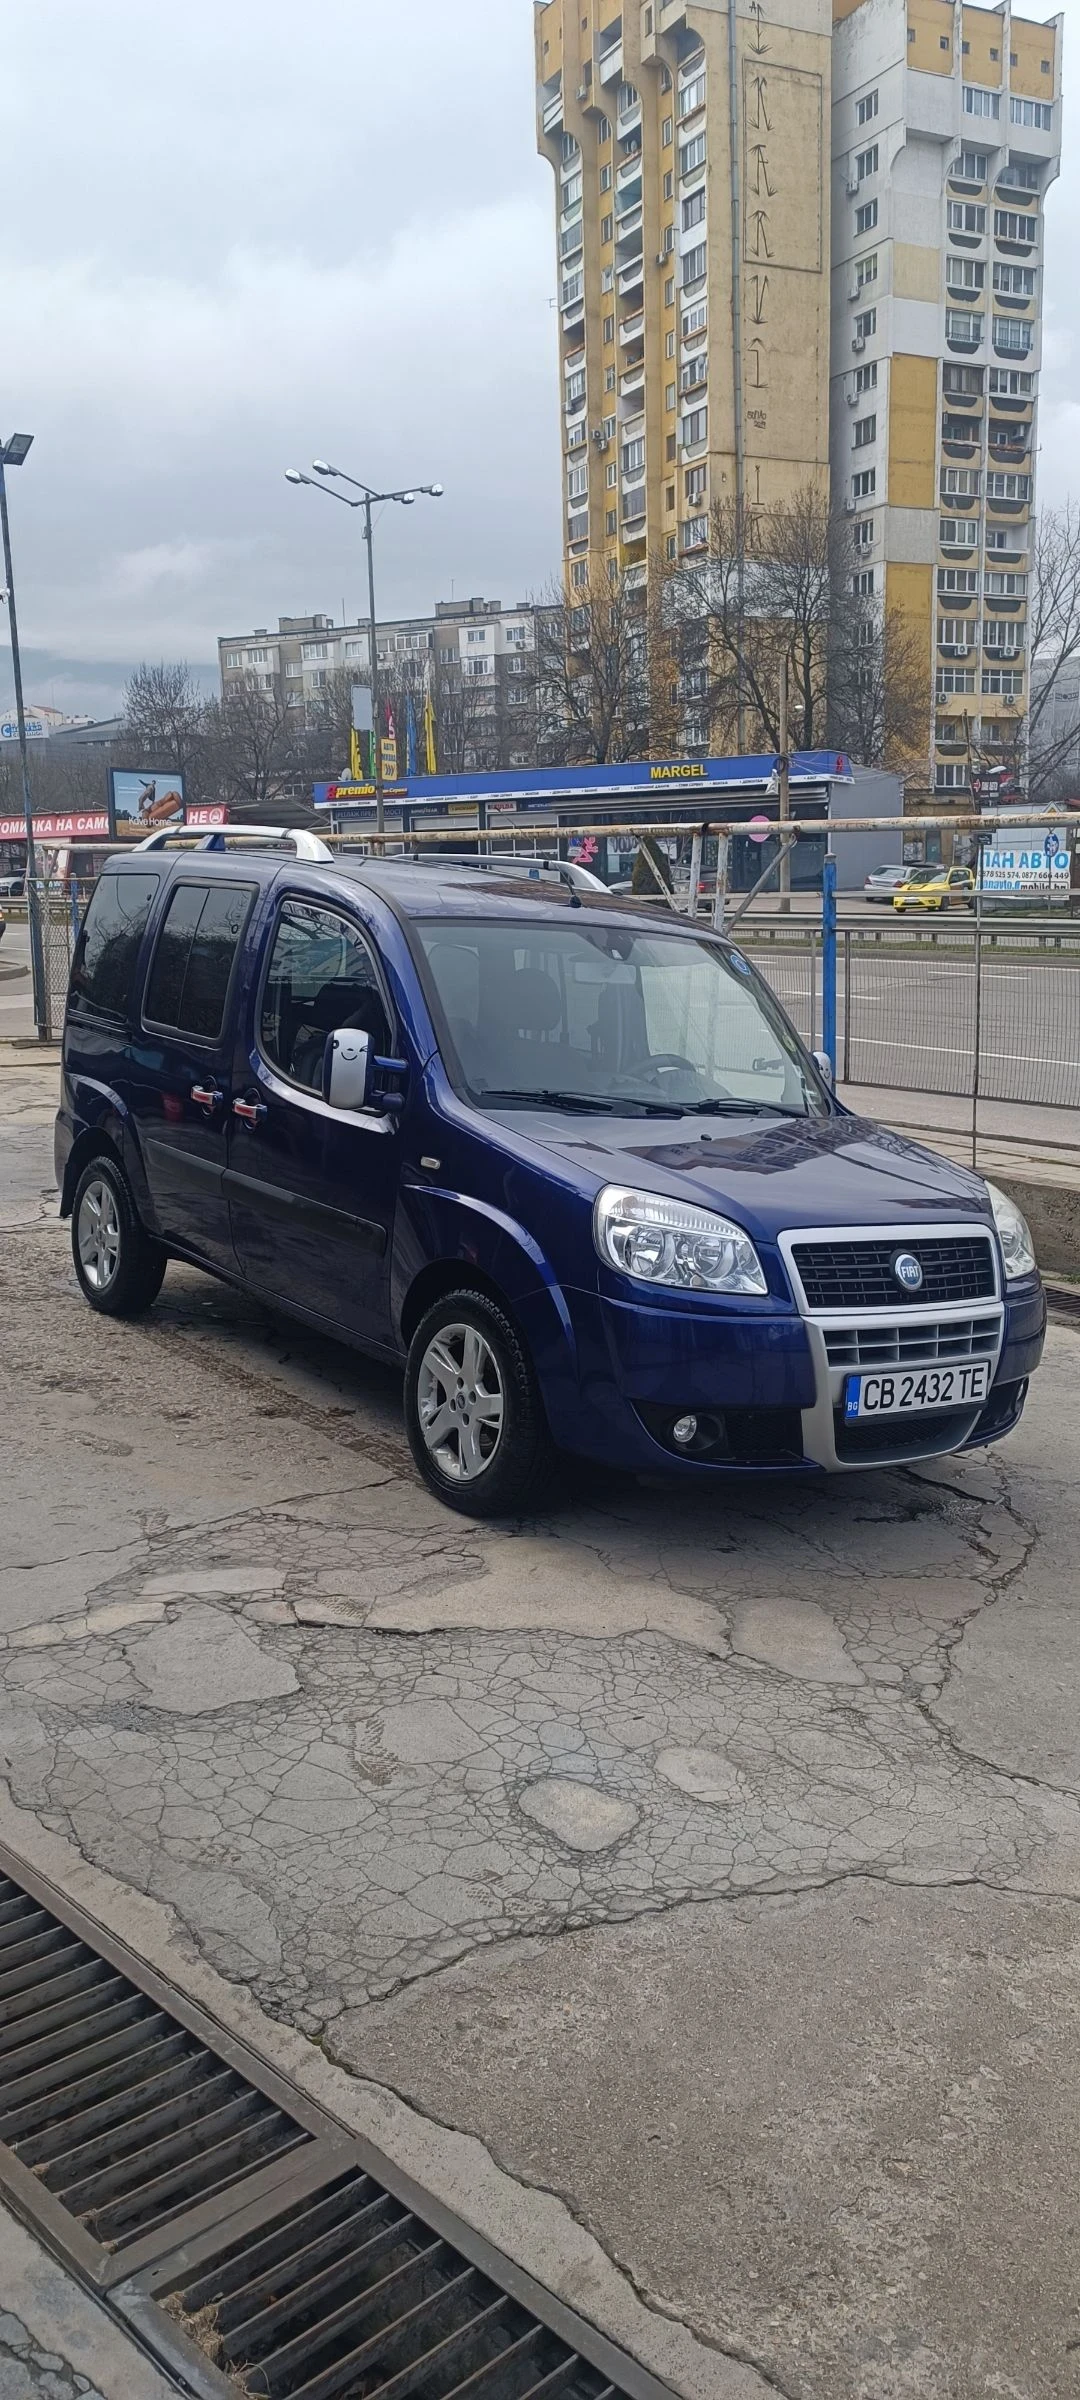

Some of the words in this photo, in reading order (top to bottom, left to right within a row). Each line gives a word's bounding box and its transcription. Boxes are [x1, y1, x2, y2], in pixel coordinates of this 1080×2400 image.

[650, 764, 709, 779] MARGEL
[336, 783, 375, 799] premio
[0, 819, 52, 834] ОМИВКА
[56, 818, 73, 831] НА
[149, 817, 172, 827] Home
[901, 1265, 919, 1279] FIAT
[847, 1401, 858, 1411] BG
[863, 1378, 895, 1410] CB
[899, 1371, 954, 1407] 2432
[959, 1367, 985, 1399] TE
